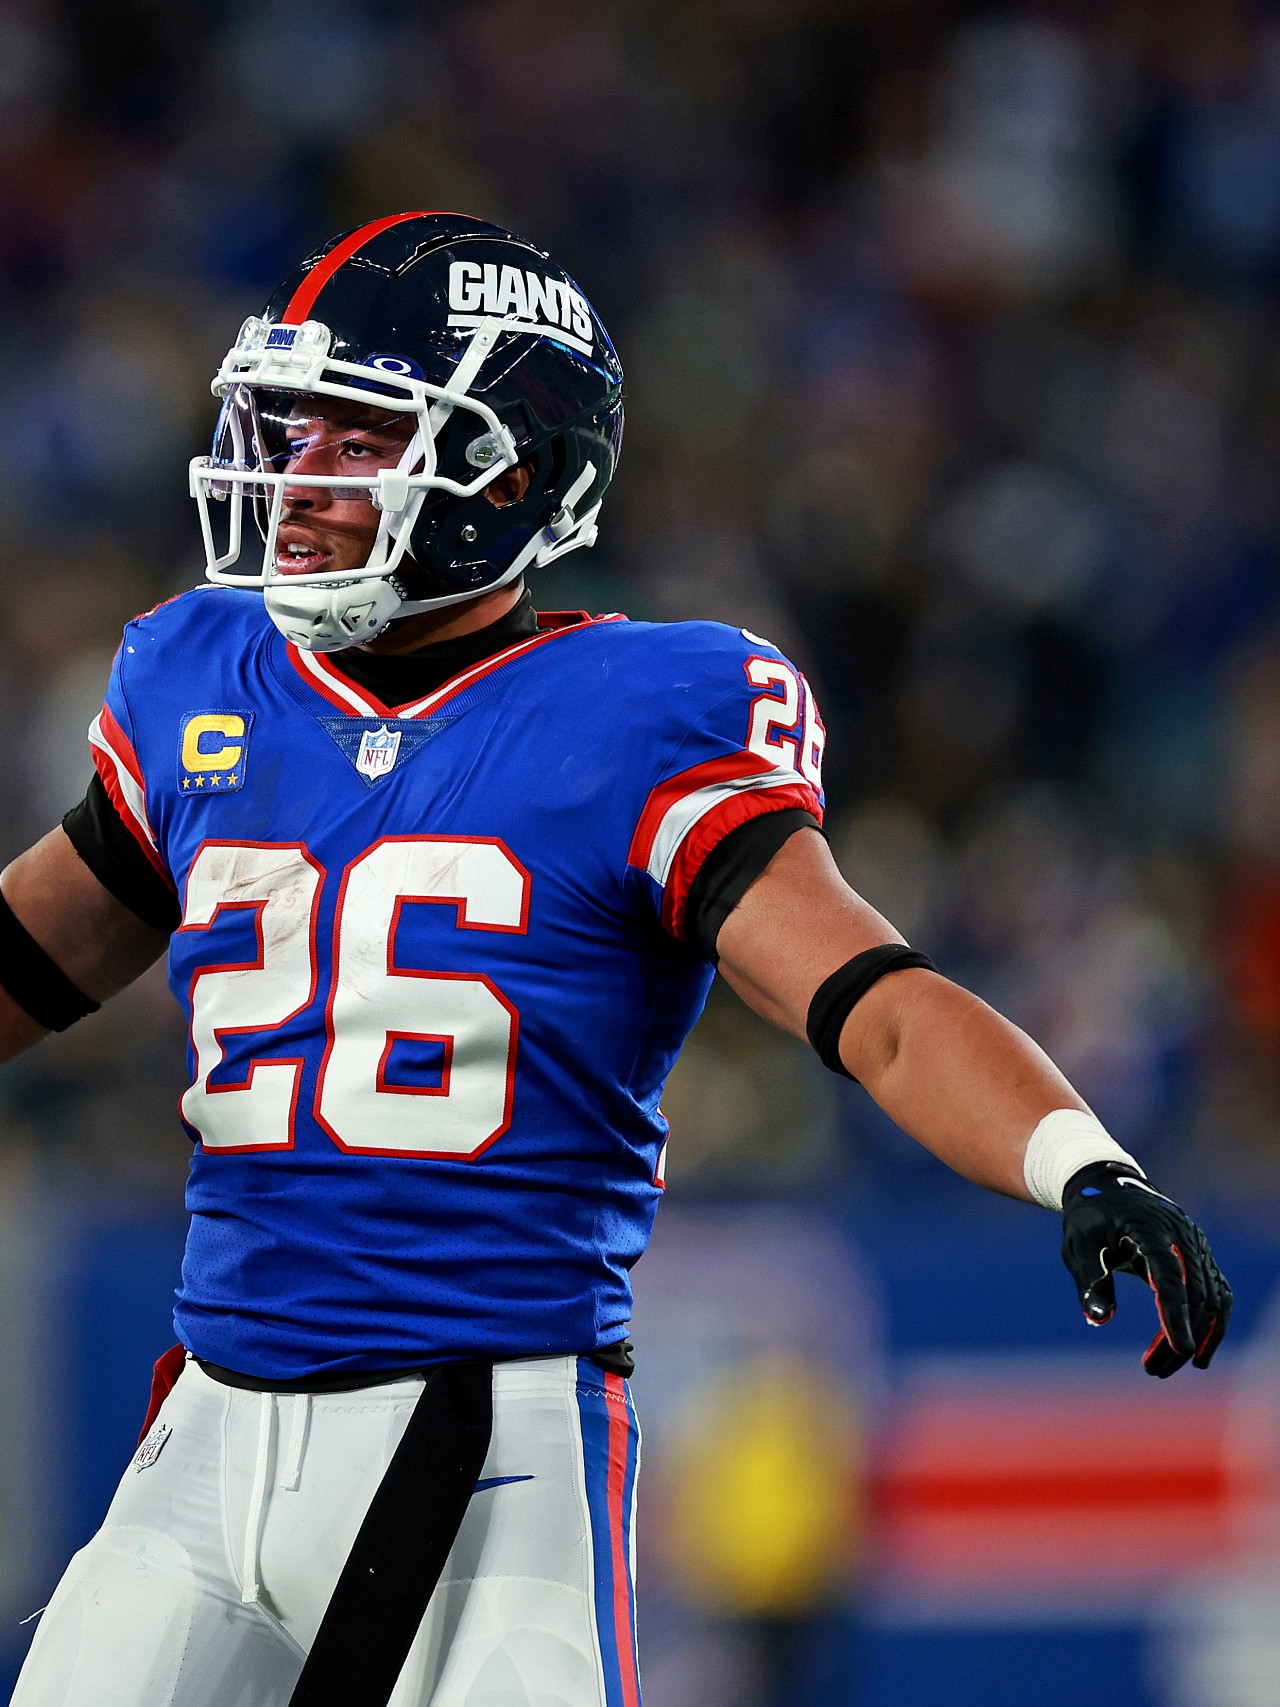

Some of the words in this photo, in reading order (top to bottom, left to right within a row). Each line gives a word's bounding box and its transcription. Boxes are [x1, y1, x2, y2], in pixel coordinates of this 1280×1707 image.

[449, 261, 593, 341] GIANTS
[181, 714, 245, 773] C
[363, 749, 389, 769] NFL
[743, 655, 826, 796] 26
[176, 834, 532, 1161] 26
